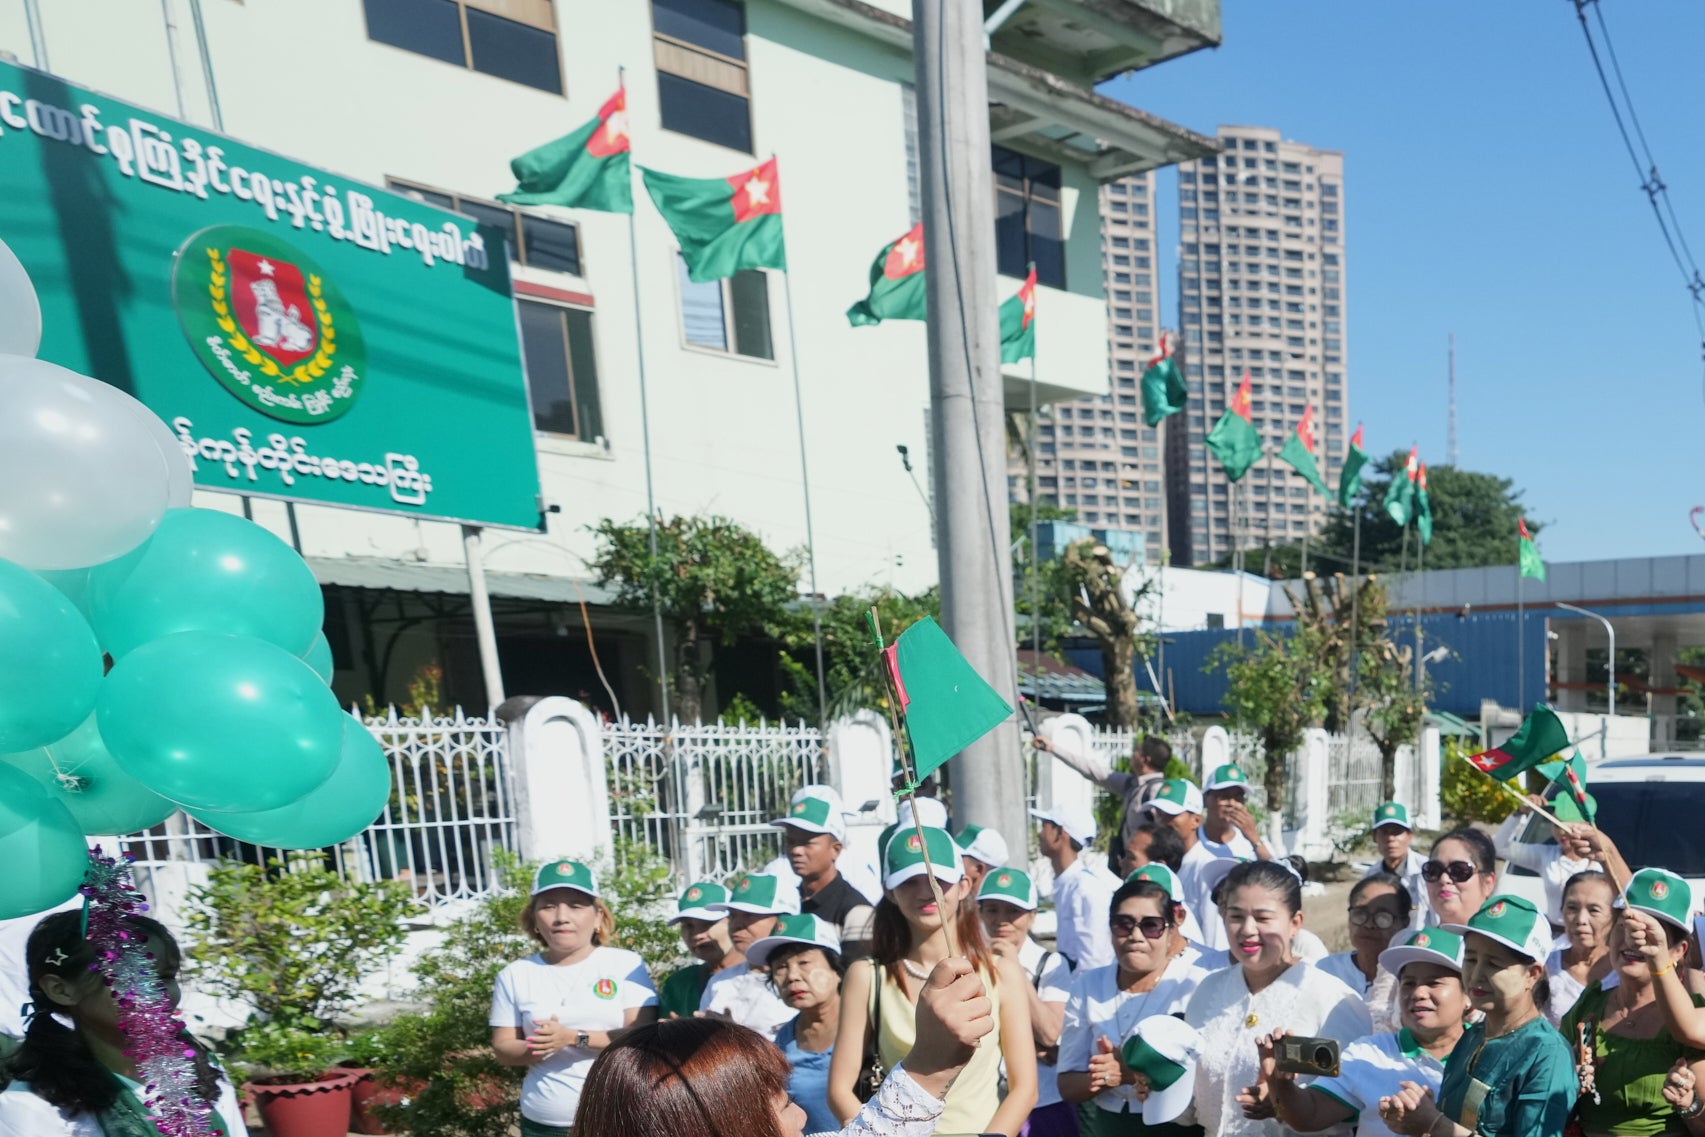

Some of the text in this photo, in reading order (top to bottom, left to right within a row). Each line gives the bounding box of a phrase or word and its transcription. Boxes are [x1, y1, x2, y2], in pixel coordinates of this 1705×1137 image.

[0, 90, 488, 271] ထောင်စုကြံ့ခိုင်ရေးနှင့်ဖွံ့ဖြိုးရေးပါတီ
[172, 416, 433, 505] န်ကုန်တိုင်းဒေသကြီး
